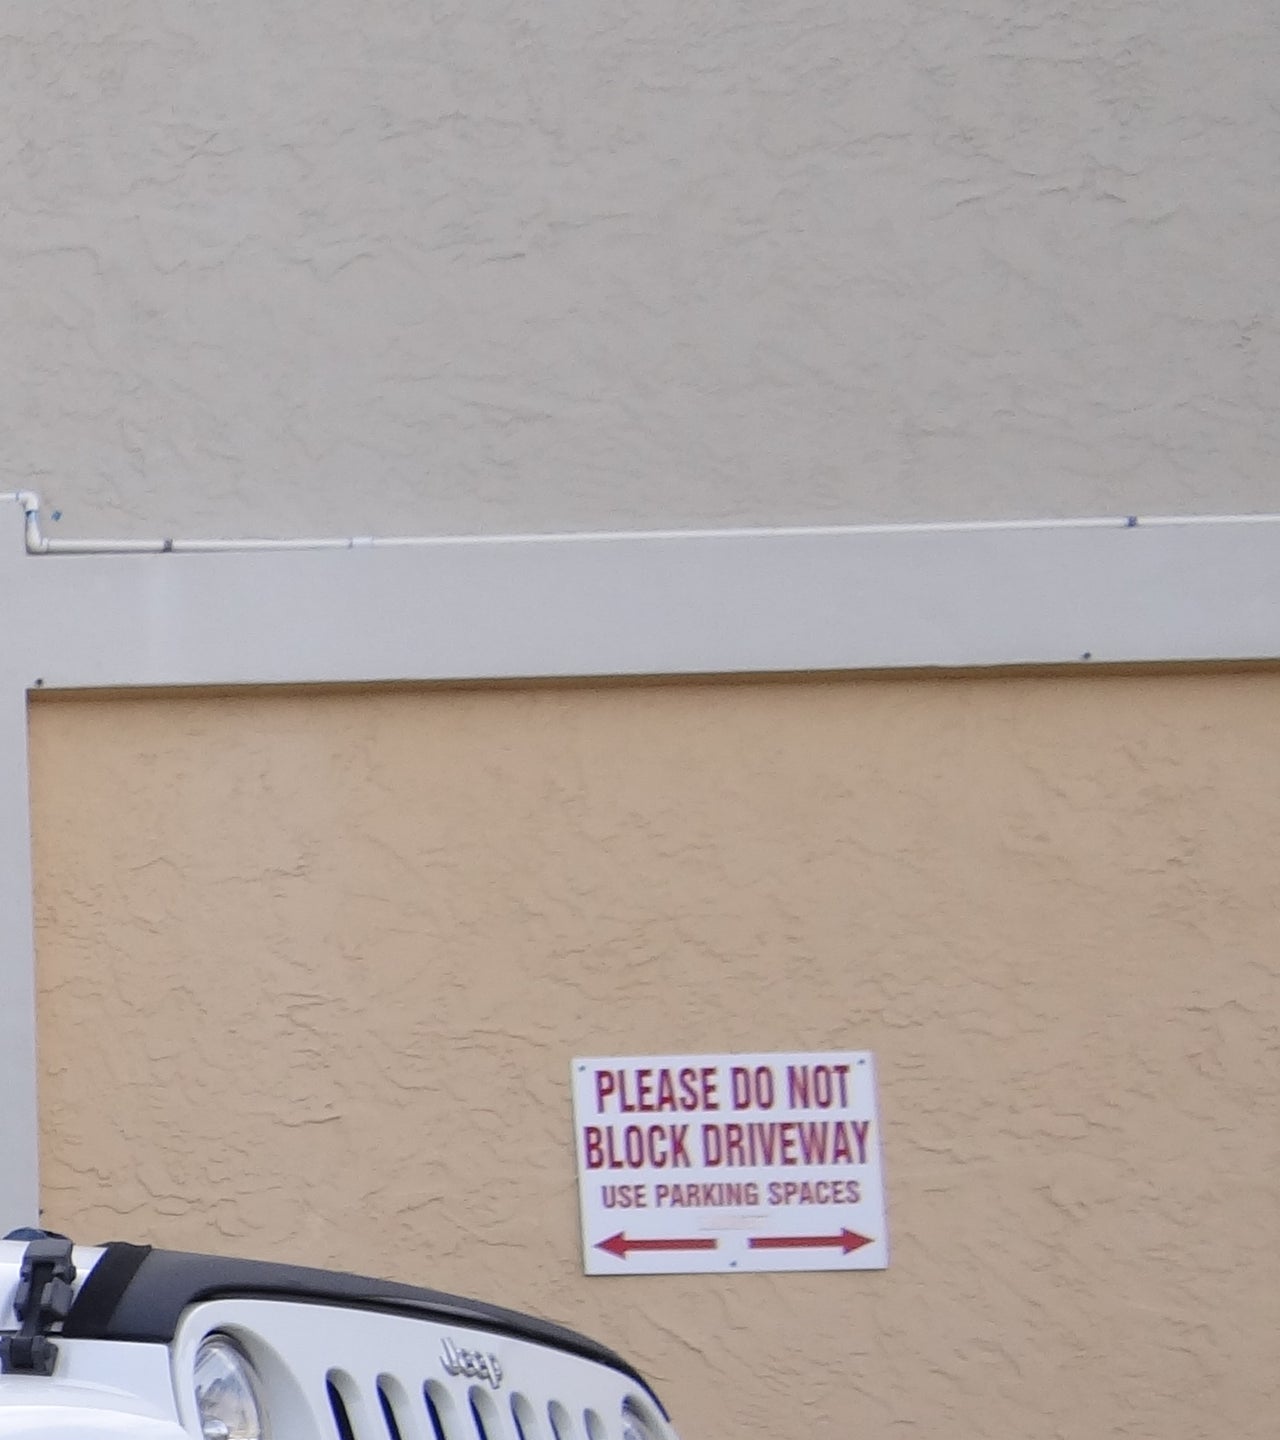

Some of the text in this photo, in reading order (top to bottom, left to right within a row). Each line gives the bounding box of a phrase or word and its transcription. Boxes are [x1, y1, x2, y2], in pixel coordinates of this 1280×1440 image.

[594, 1064, 851, 1114] PLEASE DO NOT
[583, 1120, 871, 1170] BLOCK DRIVEWAY
[601, 1180, 861, 1209] USE PARKING SPACES
[439, 1336, 503, 1390] Jeep
